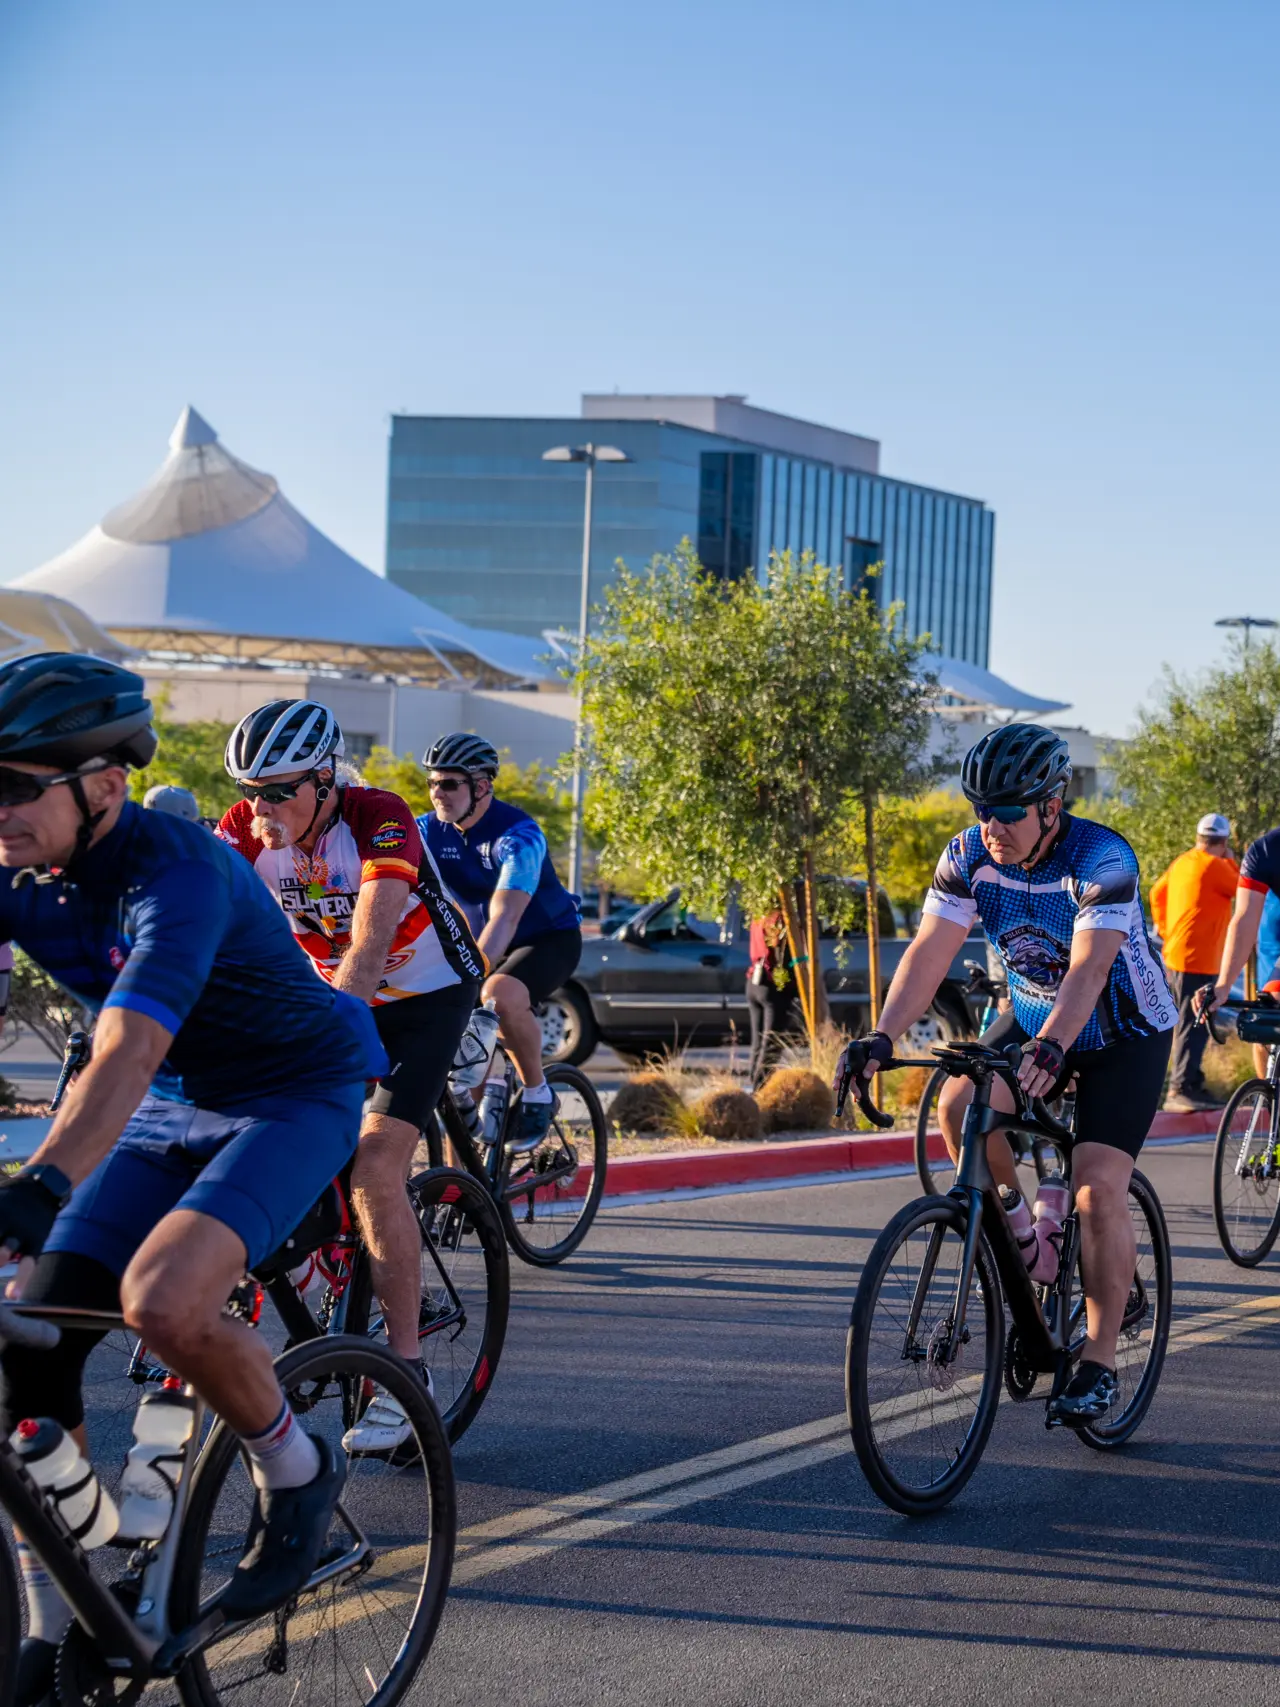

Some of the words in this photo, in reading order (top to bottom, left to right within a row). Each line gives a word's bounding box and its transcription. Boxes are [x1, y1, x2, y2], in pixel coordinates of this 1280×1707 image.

[435, 898, 462, 942] VEGAS
[456, 940, 481, 977] 2018
[1003, 926, 1027, 941] POLICE
[1014, 984, 1041, 999] TEAM
